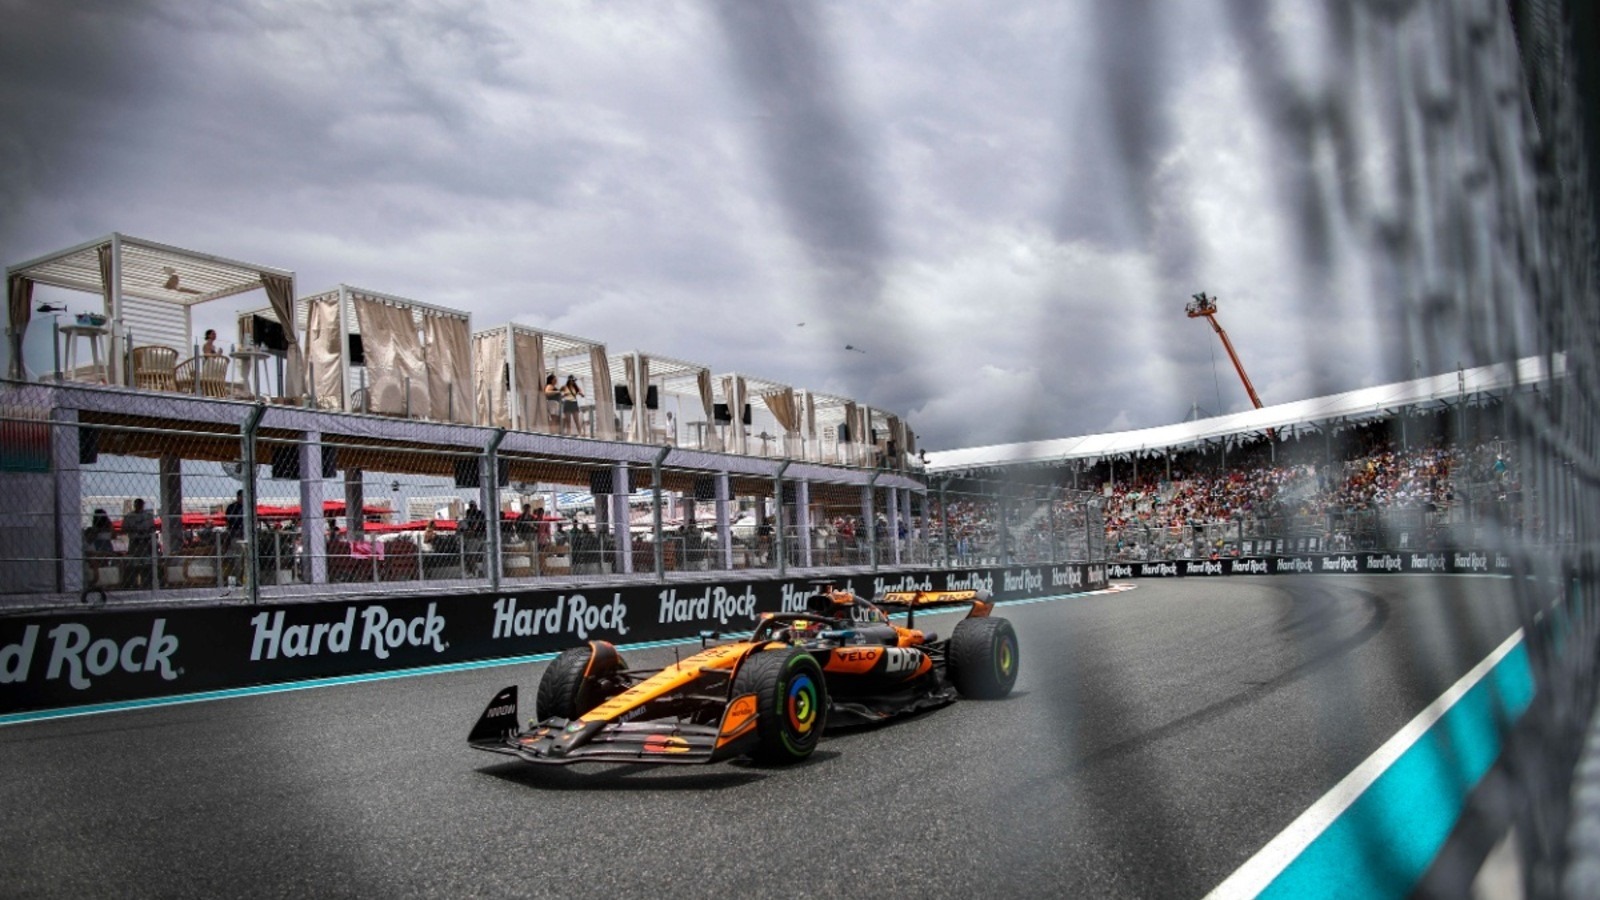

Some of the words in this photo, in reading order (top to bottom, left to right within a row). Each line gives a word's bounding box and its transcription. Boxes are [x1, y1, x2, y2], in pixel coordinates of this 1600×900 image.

[1141, 563, 1159, 575] Hard
[1160, 562, 1177, 576] Rock
[1186, 561, 1205, 573] Hard
[1205, 560, 1223, 575] Rock
[1232, 560, 1250, 572] Hard
[1250, 559, 1269, 574] Rock
[1277, 558, 1295, 570] Hard
[1295, 557, 1314, 573] Rock
[1322, 557, 1341, 570] Hard
[1341, 556, 1359, 572] Rock
[1367, 555, 1384, 569] Hard
[1384, 554, 1402, 571] Rock
[1411, 554, 1428, 568] Hard
[1428, 553, 1446, 571] Rock
[1114, 564, 1133, 577] Rock
[1004, 570, 1024, 592] Hard
[1024, 568, 1043, 594] Rock
[658, 588, 711, 623] Hard
[712, 585, 757, 624] Rock
[492, 595, 565, 639] Hard
[567, 592, 627, 640] Rock
[250, 607, 356, 660] Hard
[360, 602, 445, 659] Rock
[45, 618, 179, 690] Rock
[837, 651, 876, 663] VELO
